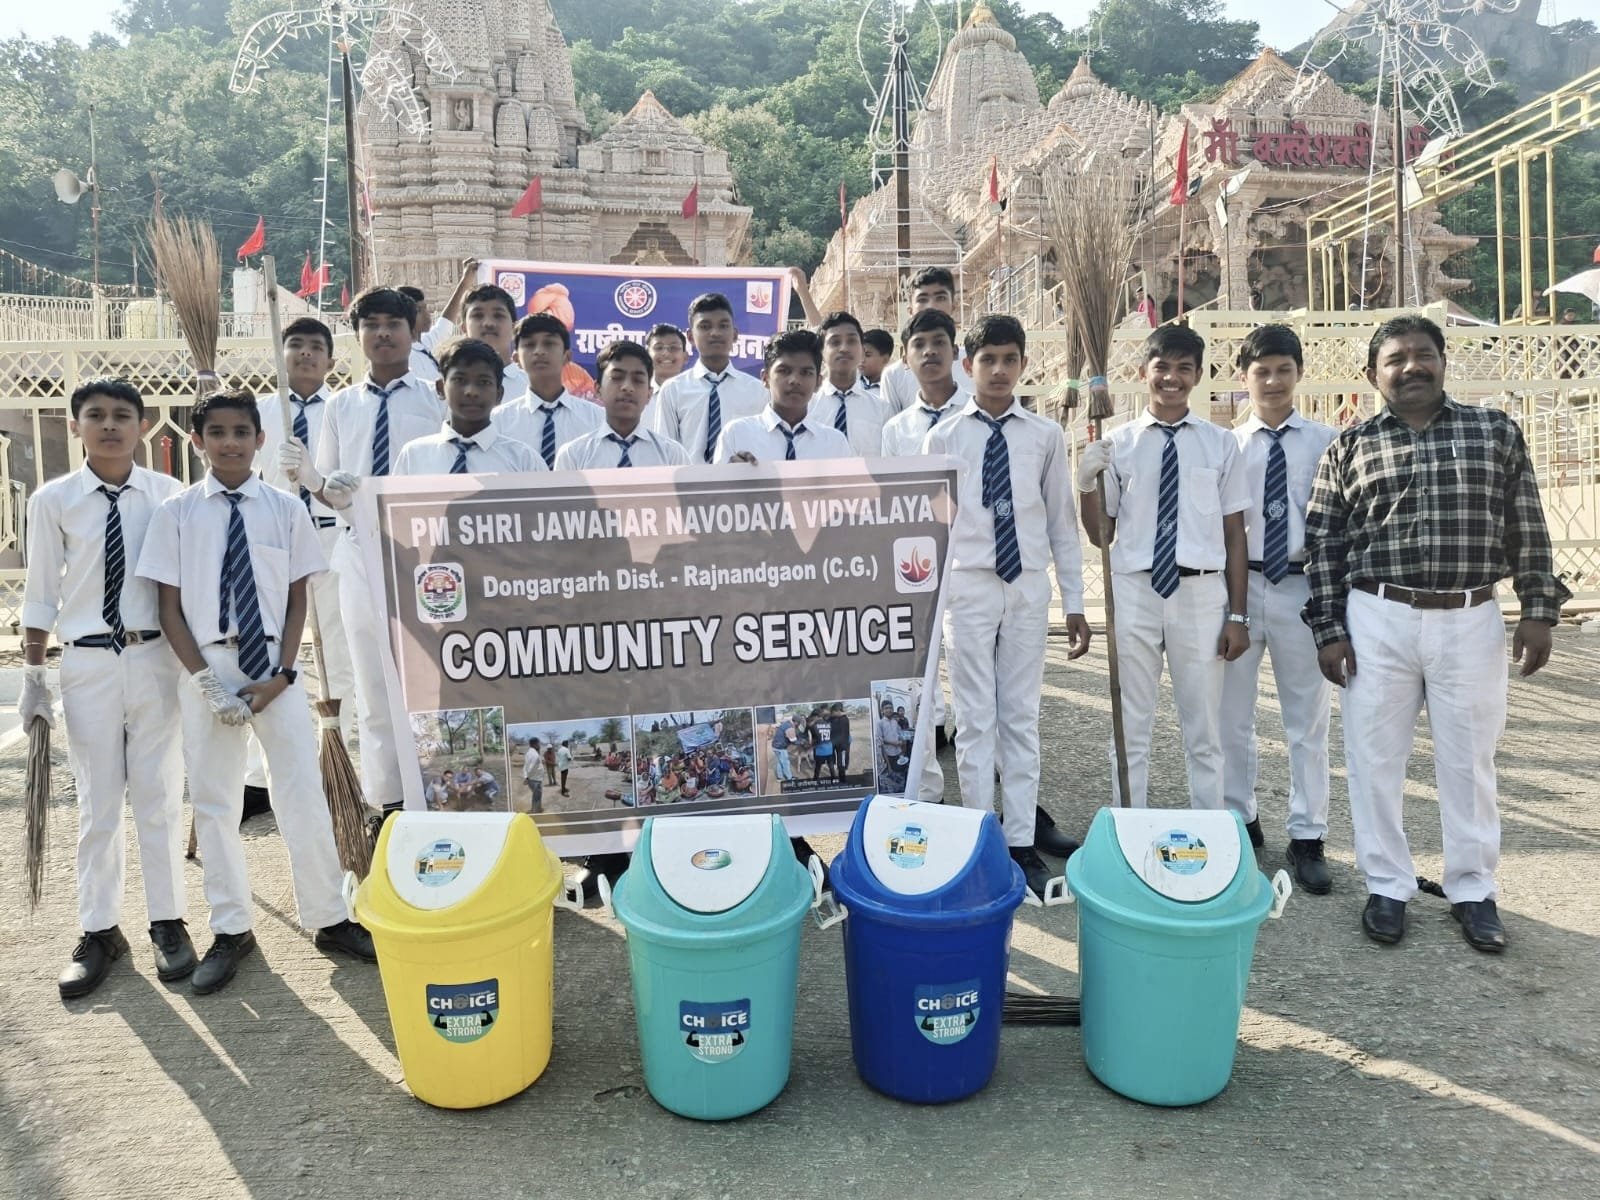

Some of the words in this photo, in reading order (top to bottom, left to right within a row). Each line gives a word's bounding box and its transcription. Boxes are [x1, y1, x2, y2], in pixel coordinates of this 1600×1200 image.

[411, 515, 450, 548] PM
[458, 512, 523, 545] SHRI
[531, 508, 659, 542] JAWAHAR
[665, 501, 797, 536] NAVODAYA
[802, 494, 935, 528] VIDYALAYA
[483, 570, 610, 601] Dongargarh
[616, 567, 665, 592] Dist.
[684, 561, 817, 591] Rajnandgaon
[822, 554, 879, 585] (C.G.)
[441, 616, 721, 682] COMMUNITY
[733, 604, 915, 662] SERVICE
[446, 1014, 482, 1029] EXTRA
[933, 1015, 966, 1028] EXTRA
[446, 1025, 483, 1038] STRONG
[933, 1026, 966, 1038] STRONG
[698, 1033, 733, 1047] EXTRA
[698, 1045, 733, 1057] STRONG
